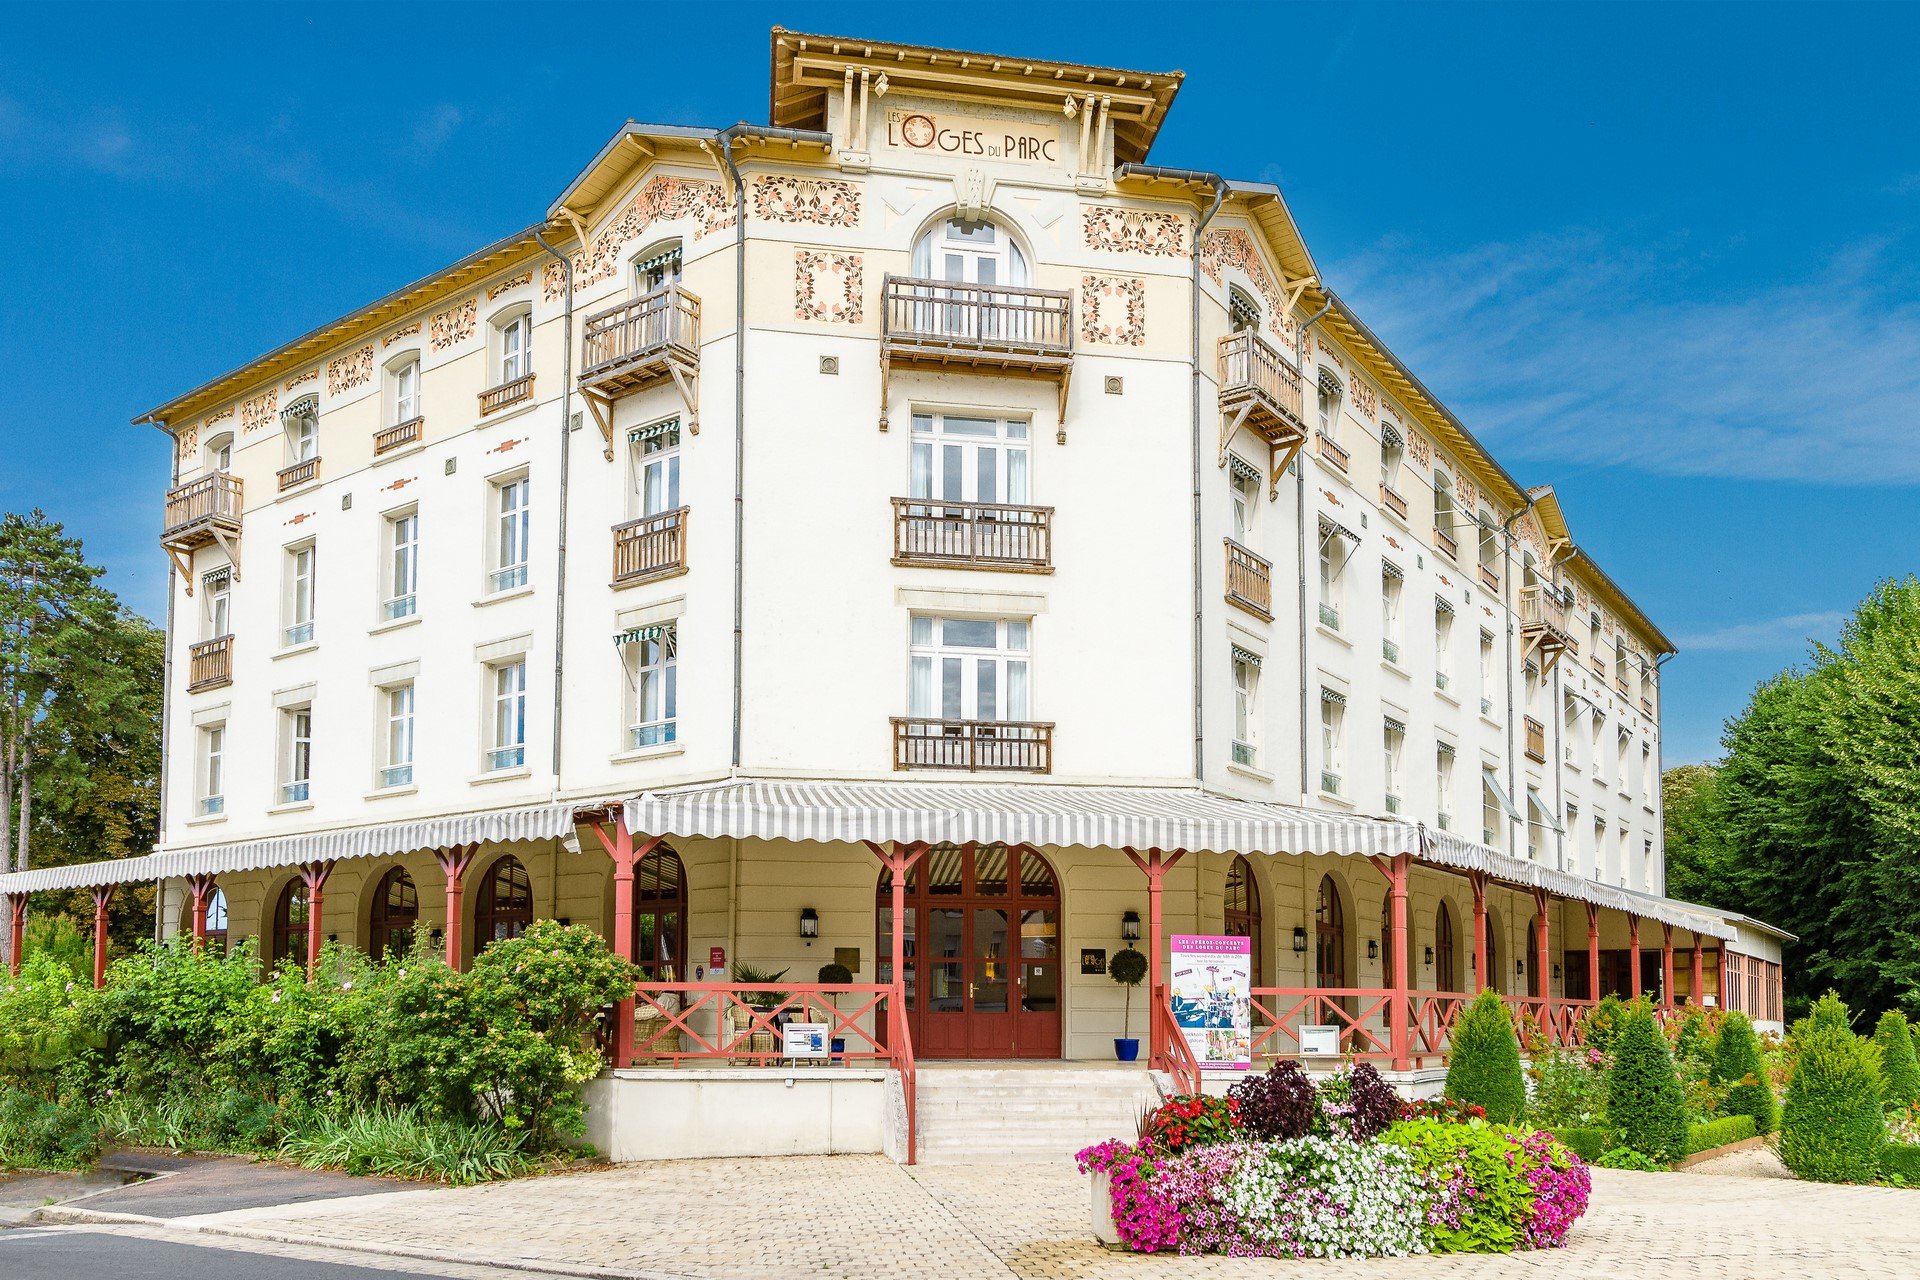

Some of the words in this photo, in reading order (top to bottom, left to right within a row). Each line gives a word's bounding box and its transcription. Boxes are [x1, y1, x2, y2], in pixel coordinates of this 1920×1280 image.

[887, 111, 901, 123] LES
[888, 114, 984, 155] LOGES
[988, 145, 1001, 157] DU
[1004, 134, 1055, 161] PARC
